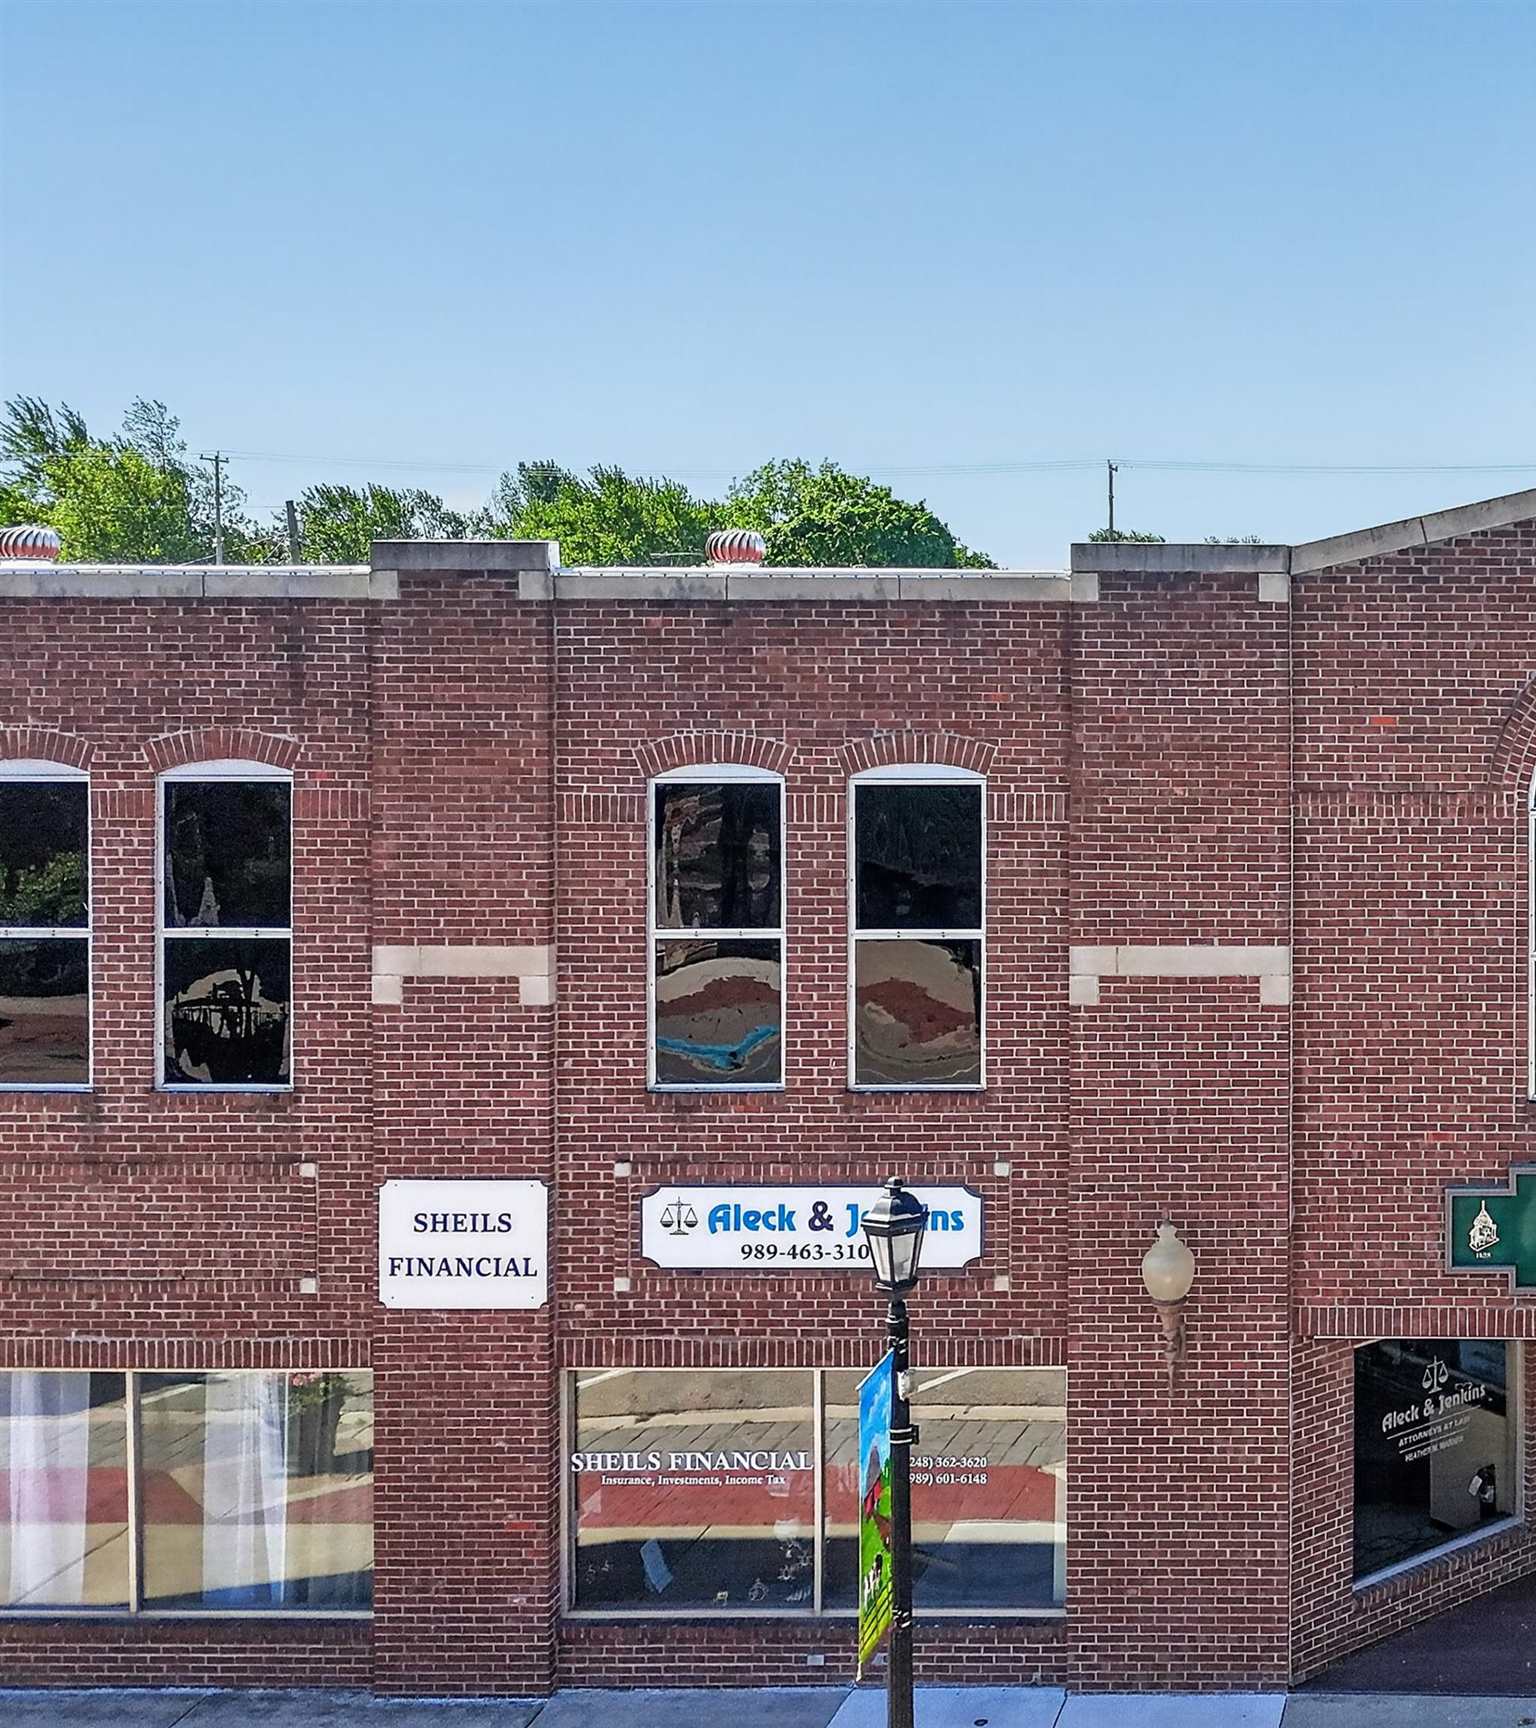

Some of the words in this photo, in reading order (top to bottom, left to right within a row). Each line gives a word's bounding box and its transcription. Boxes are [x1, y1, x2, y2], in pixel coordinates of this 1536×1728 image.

[413, 1212, 514, 1234] SHEILS
[708, 1203, 798, 1235] Aleck
[808, 1200, 834, 1232] &
[741, 1243, 871, 1261] 989-463-310
[388, 1256, 539, 1279] FINANCIAL
[1382, 1404, 1420, 1433] Aleck
[1423, 1398, 1435, 1417] &
[1438, 1384, 1486, 1415] Jenkins
[570, 1451, 661, 1473] SHEILS
[668, 1451, 815, 1472] FINANCIAL
[909, 1456, 934, 1470] 248)
[935, 1456, 988, 1468] 362-3620
[601, 1474, 655, 1487] Insurance,
[658, 1474, 723, 1487] Investments,
[725, 1474, 764, 1486] Income
[765, 1474, 785, 1486] Tax
[908, 1473, 934, 1487] 989)
[935, 1473, 988, 1485] 601-6148
